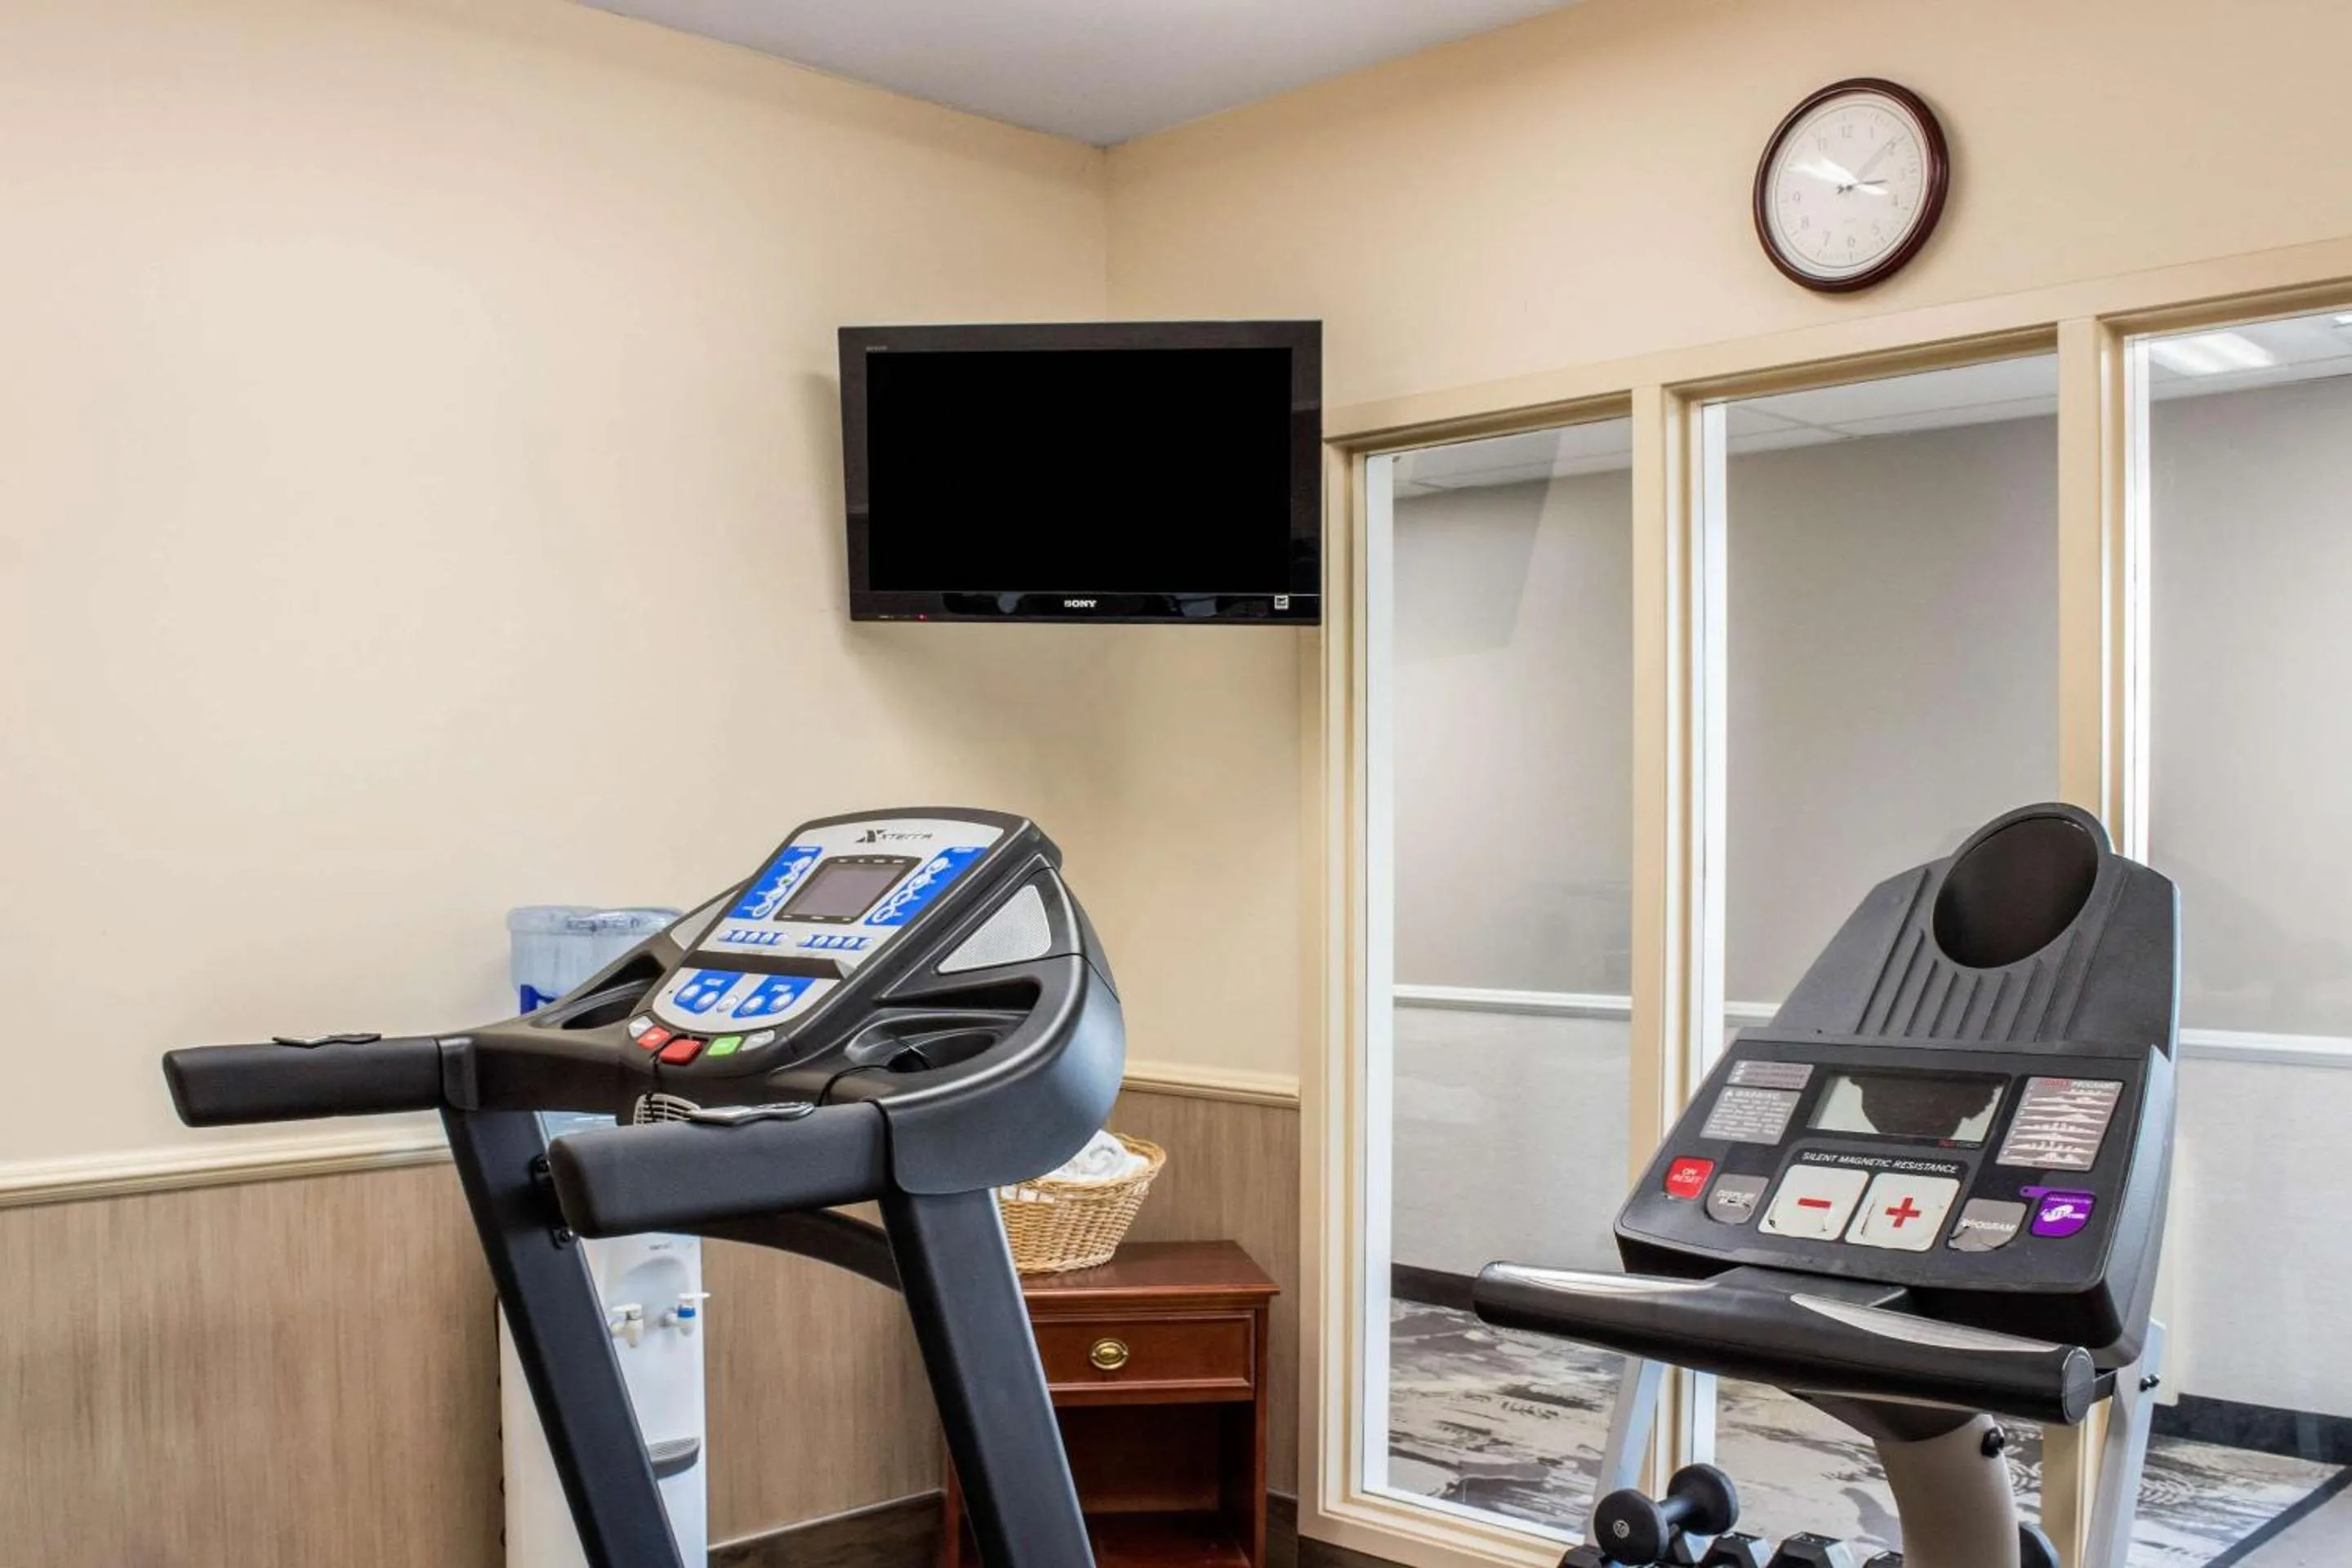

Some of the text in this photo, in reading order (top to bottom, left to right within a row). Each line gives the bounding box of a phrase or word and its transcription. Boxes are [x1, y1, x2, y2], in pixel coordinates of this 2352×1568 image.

[1064, 599, 1097, 608] SONY
[1802, 1152, 1958, 1174] SILENT MAGNETIC RESISTANCE
